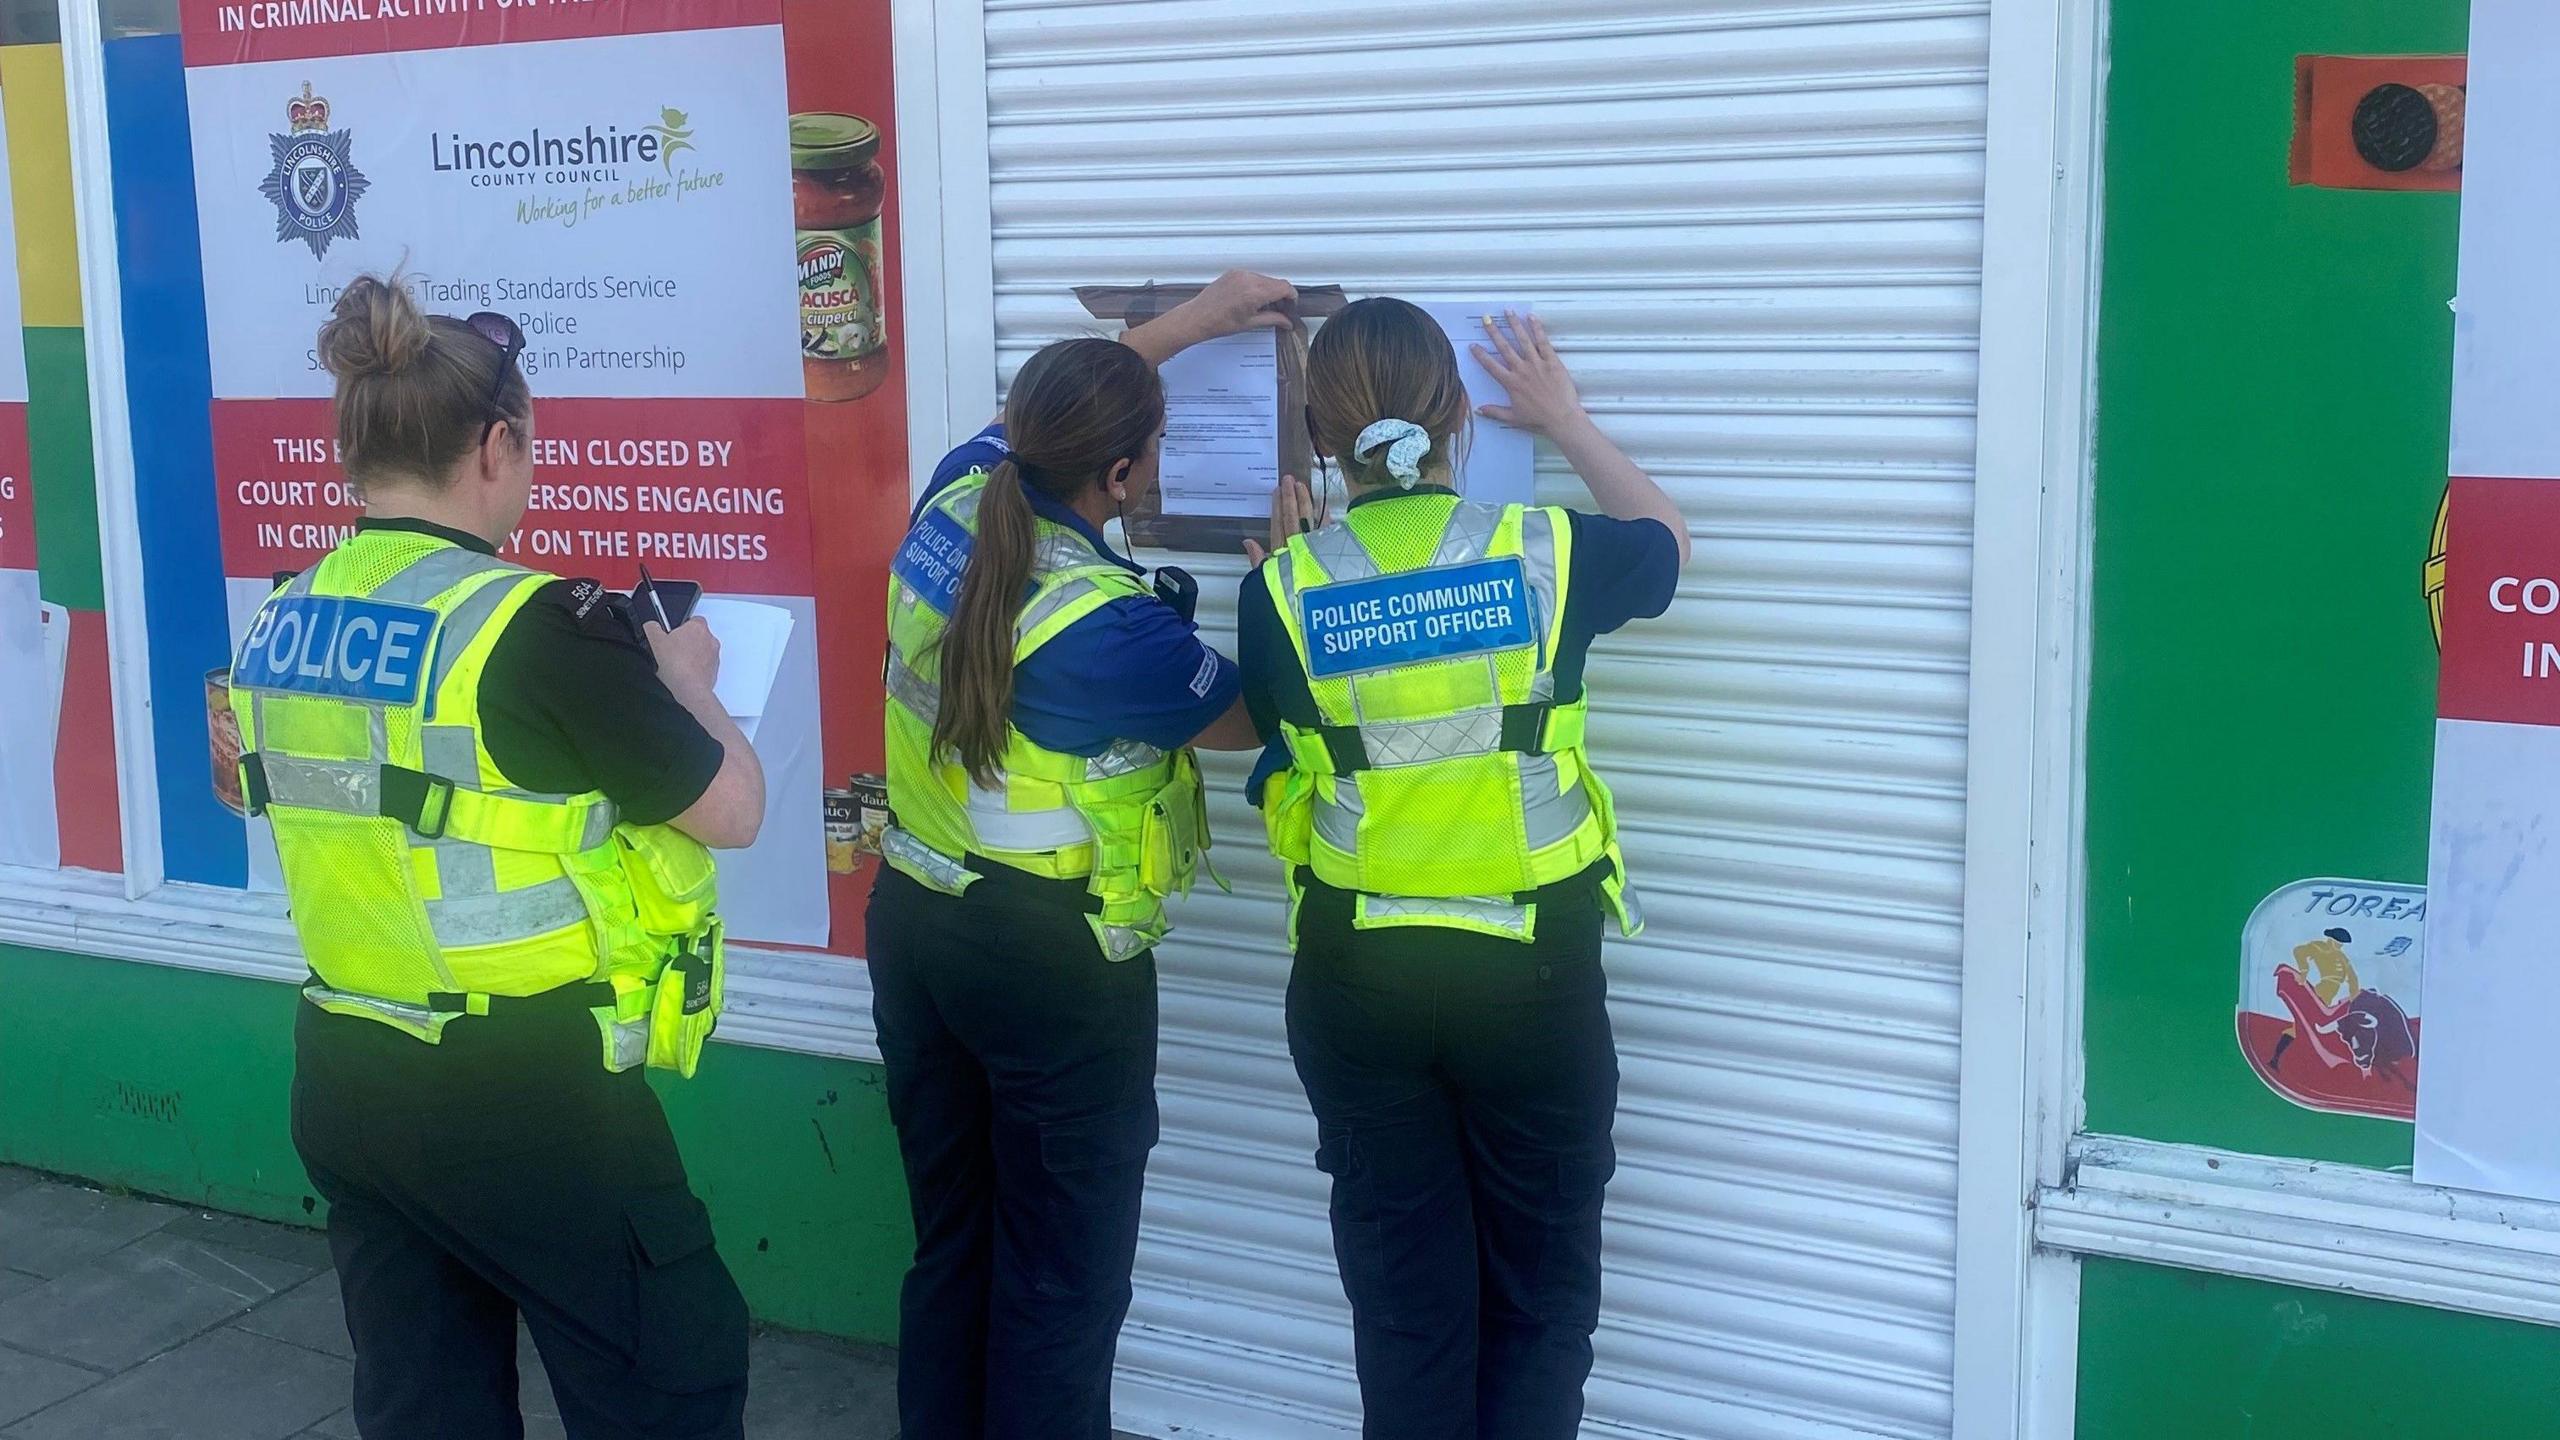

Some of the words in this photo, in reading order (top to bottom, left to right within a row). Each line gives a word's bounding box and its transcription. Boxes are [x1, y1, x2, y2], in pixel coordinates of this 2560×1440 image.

[218, 6, 245, 31] IN
[250, 0, 371, 29] CRIMINAL
[283, 143, 342, 176] LINCOLNSHIRE
[431, 125, 658, 171] Lincolnshire
[470, 172, 537, 187] COUNTY
[545, 169, 620, 185] COUNCIL
[516, 193, 578, 229] Working
[583, 187, 606, 220] for
[610, 192, 622, 207] a
[627, 174, 672, 204] better
[677, 167, 725, 203] future
[298, 211, 334, 229] POLICE
[419, 279, 492, 307] Trading
[496, 276, 598, 301] Standards
[603, 274, 677, 299] Service
[800, 282, 860, 308] ACUSCĂ
[810, 271, 832, 286] FOODS
[519, 311, 578, 335] Police
[807, 308, 858, 328] ciuperci
[543, 346, 561, 369] in
[567, 344, 686, 375] Partnership
[273, 438, 327, 463] THIS
[531, 440, 578, 465] EEN
[586, 440, 690, 467] CLOSED
[697, 440, 733, 467] BY
[237, 481, 317, 506] COURT
[528, 484, 630, 512] ERSONS
[636, 486, 785, 514] ENGAGING
[257, 523, 283, 549] IN
[530, 529, 572, 556] ON
[578, 530, 629, 557] THE
[636, 532, 768, 561] PREMISES
[915, 521, 953, 557] POLICE
[905, 541, 950, 587] SUPPORT
[570, 582, 594, 601] 564
[1311, 600, 1384, 631] POLICE
[1388, 578, 1516, 616] COMMUNITY
[2488, 576, 2560, 615] CO
[239, 605, 421, 687] POLICE
[1322, 619, 1418, 655] SUPPORT
[1425, 605, 1513, 640] OFFICER
